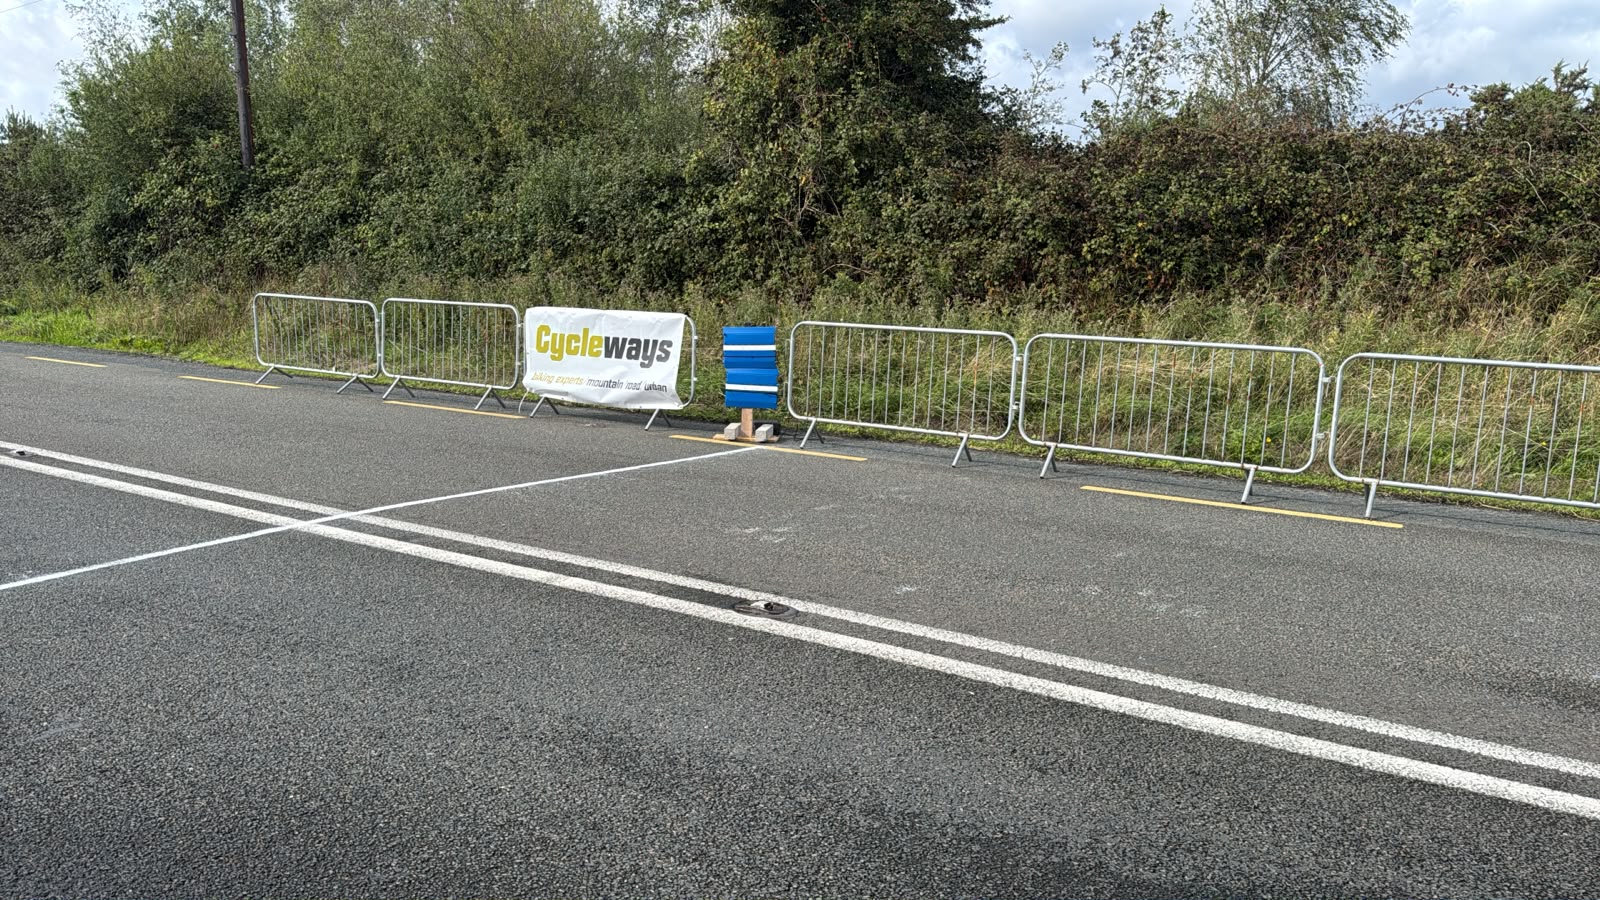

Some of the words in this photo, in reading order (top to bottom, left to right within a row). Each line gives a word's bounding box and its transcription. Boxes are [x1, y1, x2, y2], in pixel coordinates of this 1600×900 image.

[536, 325, 673, 368] Cycleways
[531, 372, 555, 384] biking
[555, 376, 584, 386] experts
